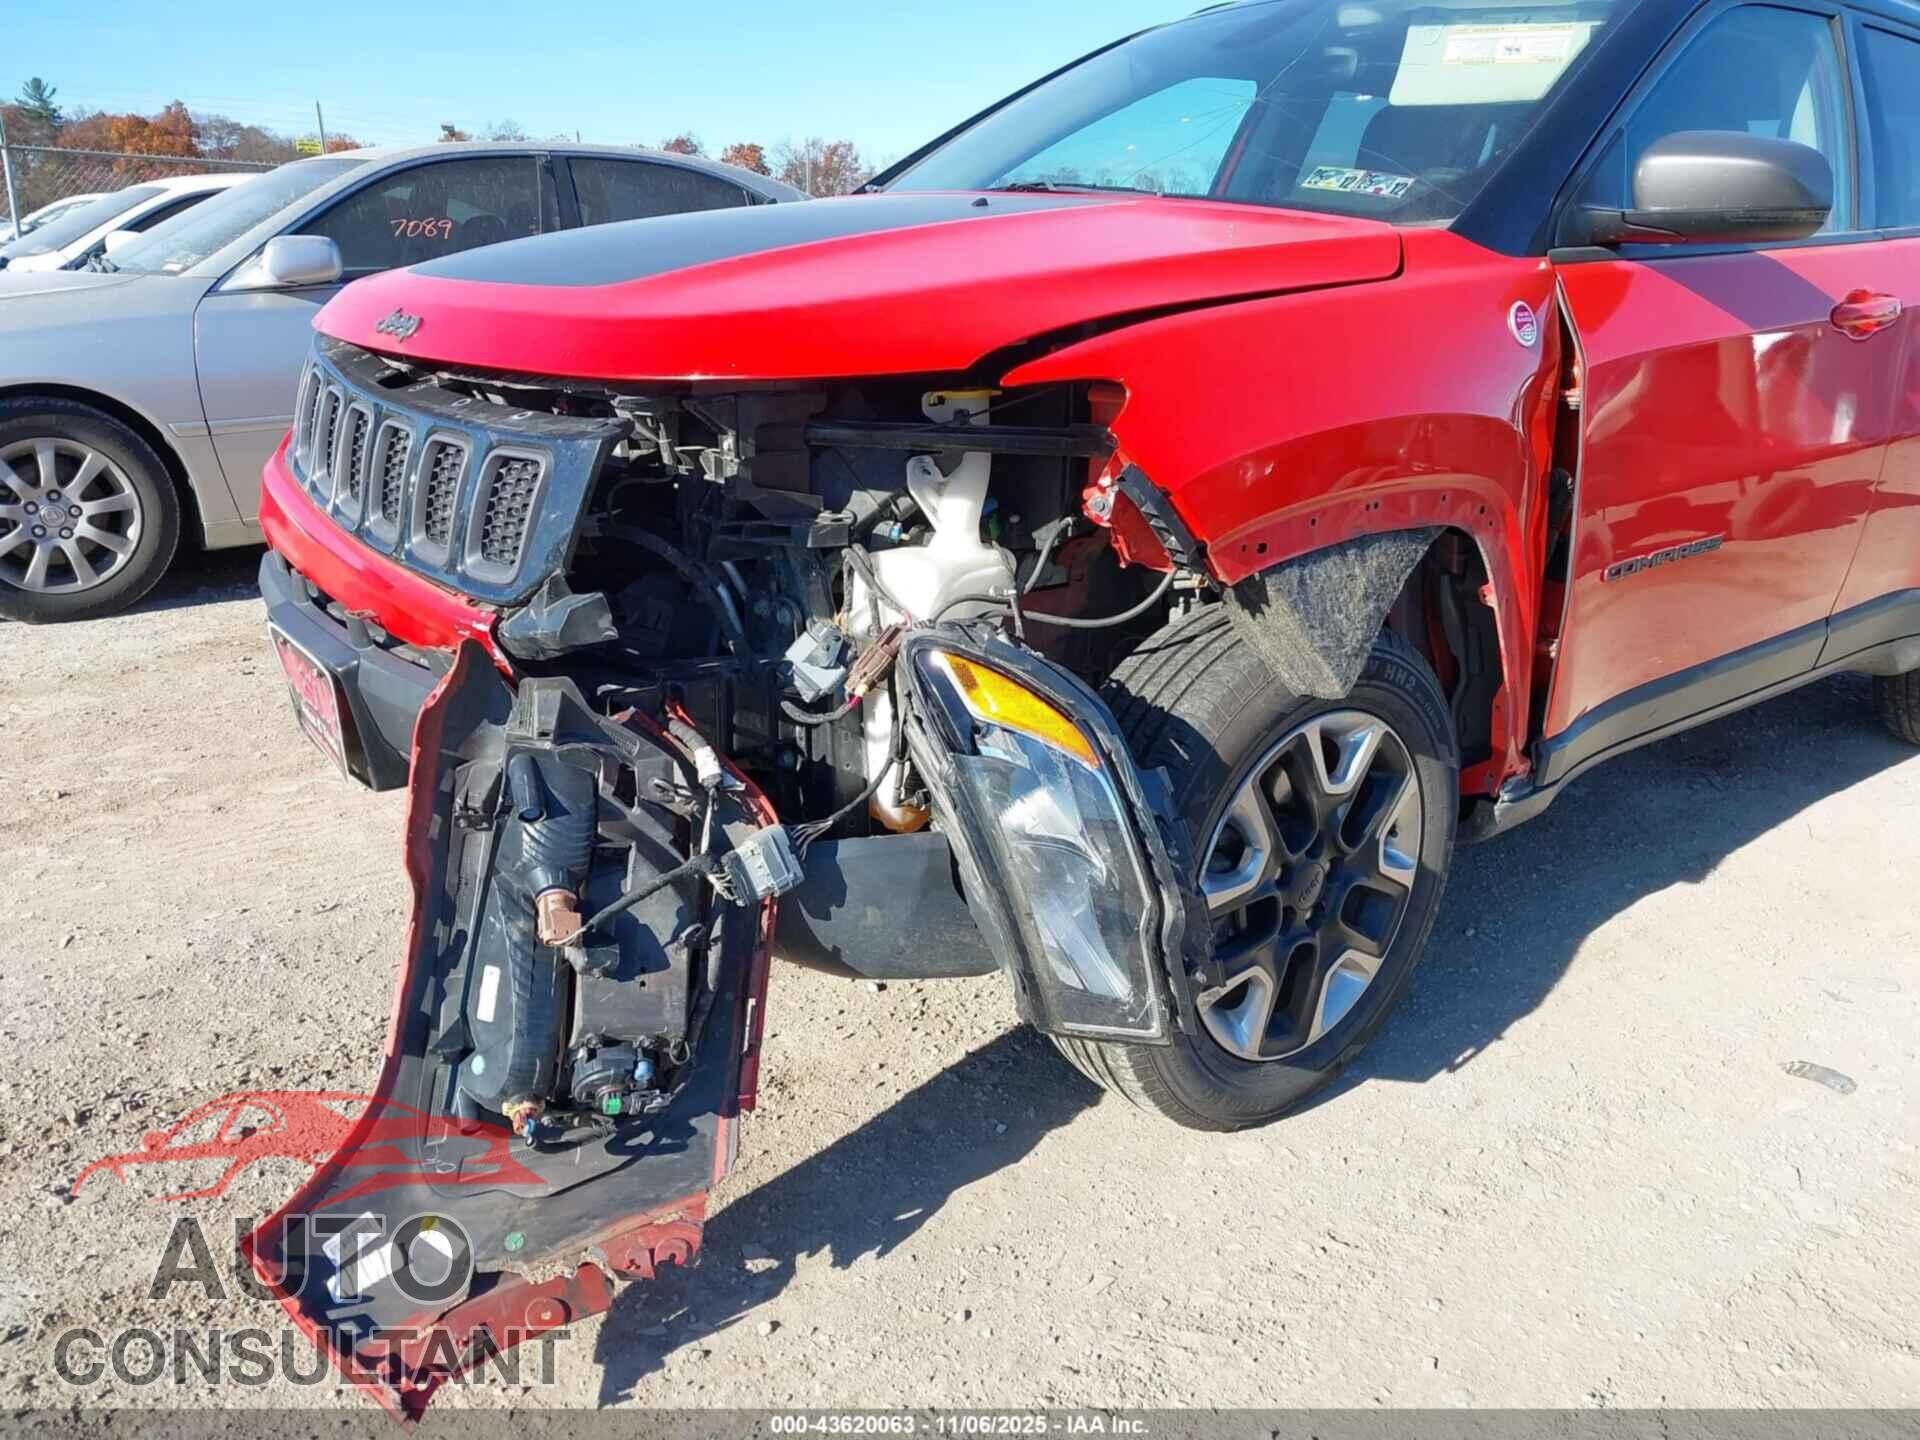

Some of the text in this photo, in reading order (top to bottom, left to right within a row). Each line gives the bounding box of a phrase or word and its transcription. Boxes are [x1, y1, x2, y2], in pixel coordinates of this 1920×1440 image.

[389, 217, 453, 240] 7089
[375, 307, 424, 344] Jeep
[1604, 534, 1725, 582] COMPASS
